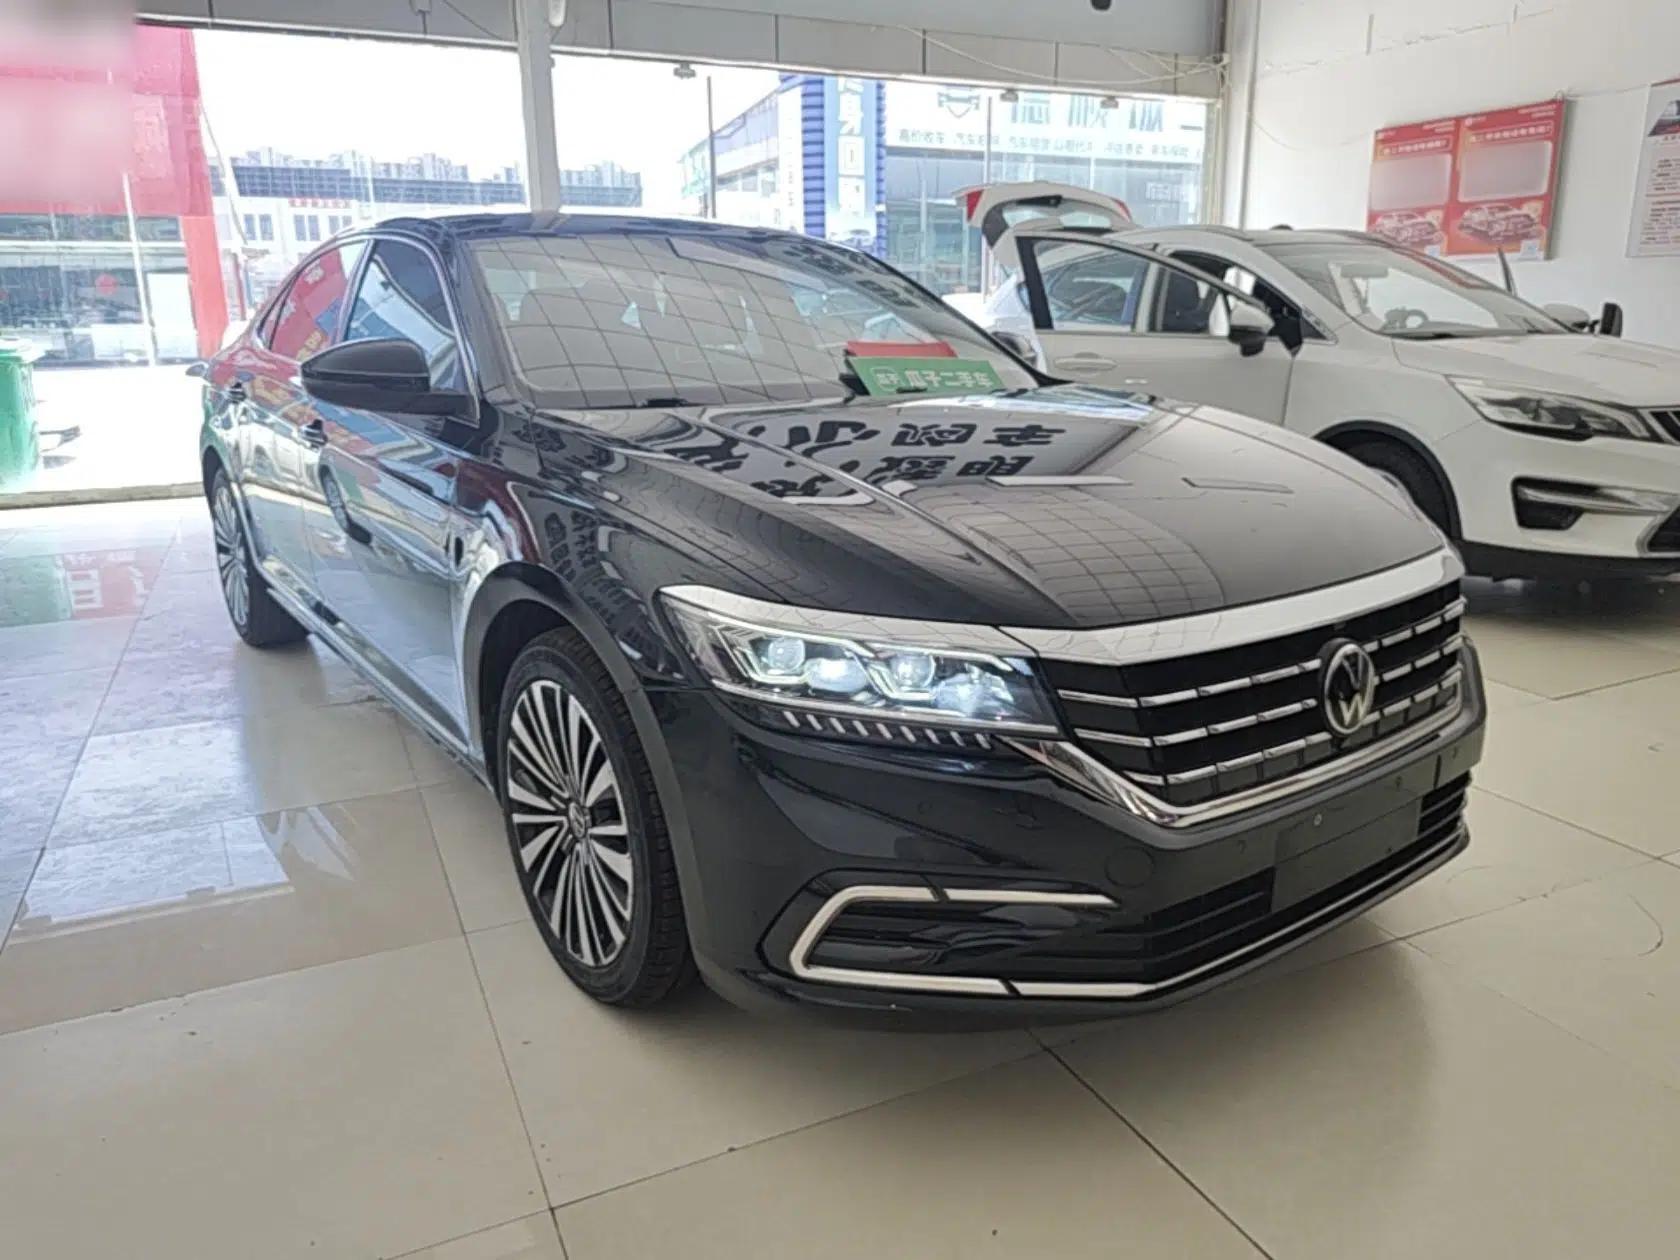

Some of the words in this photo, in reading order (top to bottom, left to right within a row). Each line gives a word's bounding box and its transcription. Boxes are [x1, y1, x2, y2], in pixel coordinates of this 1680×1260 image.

[904, 370, 994, 388] 瓜子二手车
